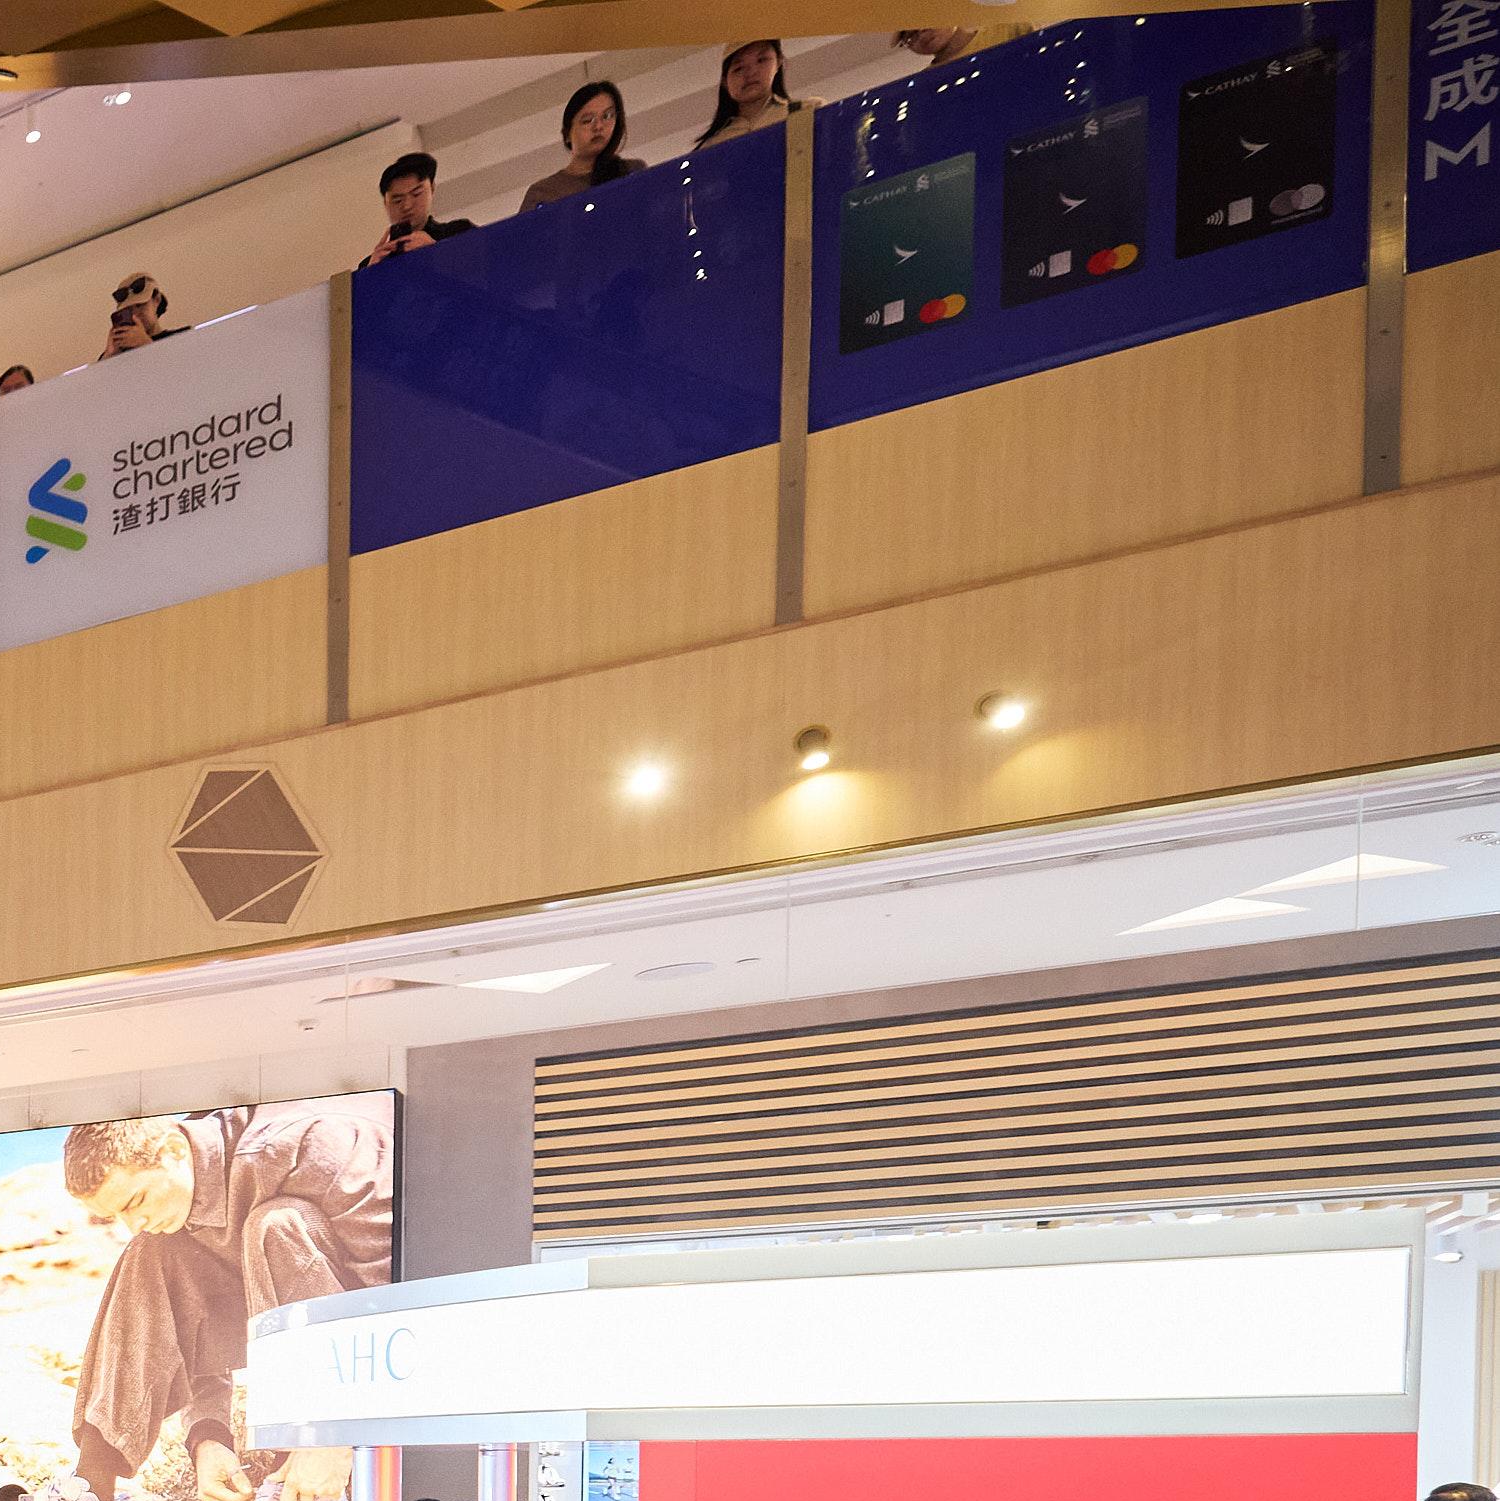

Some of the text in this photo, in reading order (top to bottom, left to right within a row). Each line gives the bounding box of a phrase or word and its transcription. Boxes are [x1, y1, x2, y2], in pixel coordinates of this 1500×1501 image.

[1205, 72, 1258, 95] CATHAY
[112, 393, 282, 472] standard
[112, 421, 293, 499] chartered
[112, 473, 241, 536] 渣打銀行
